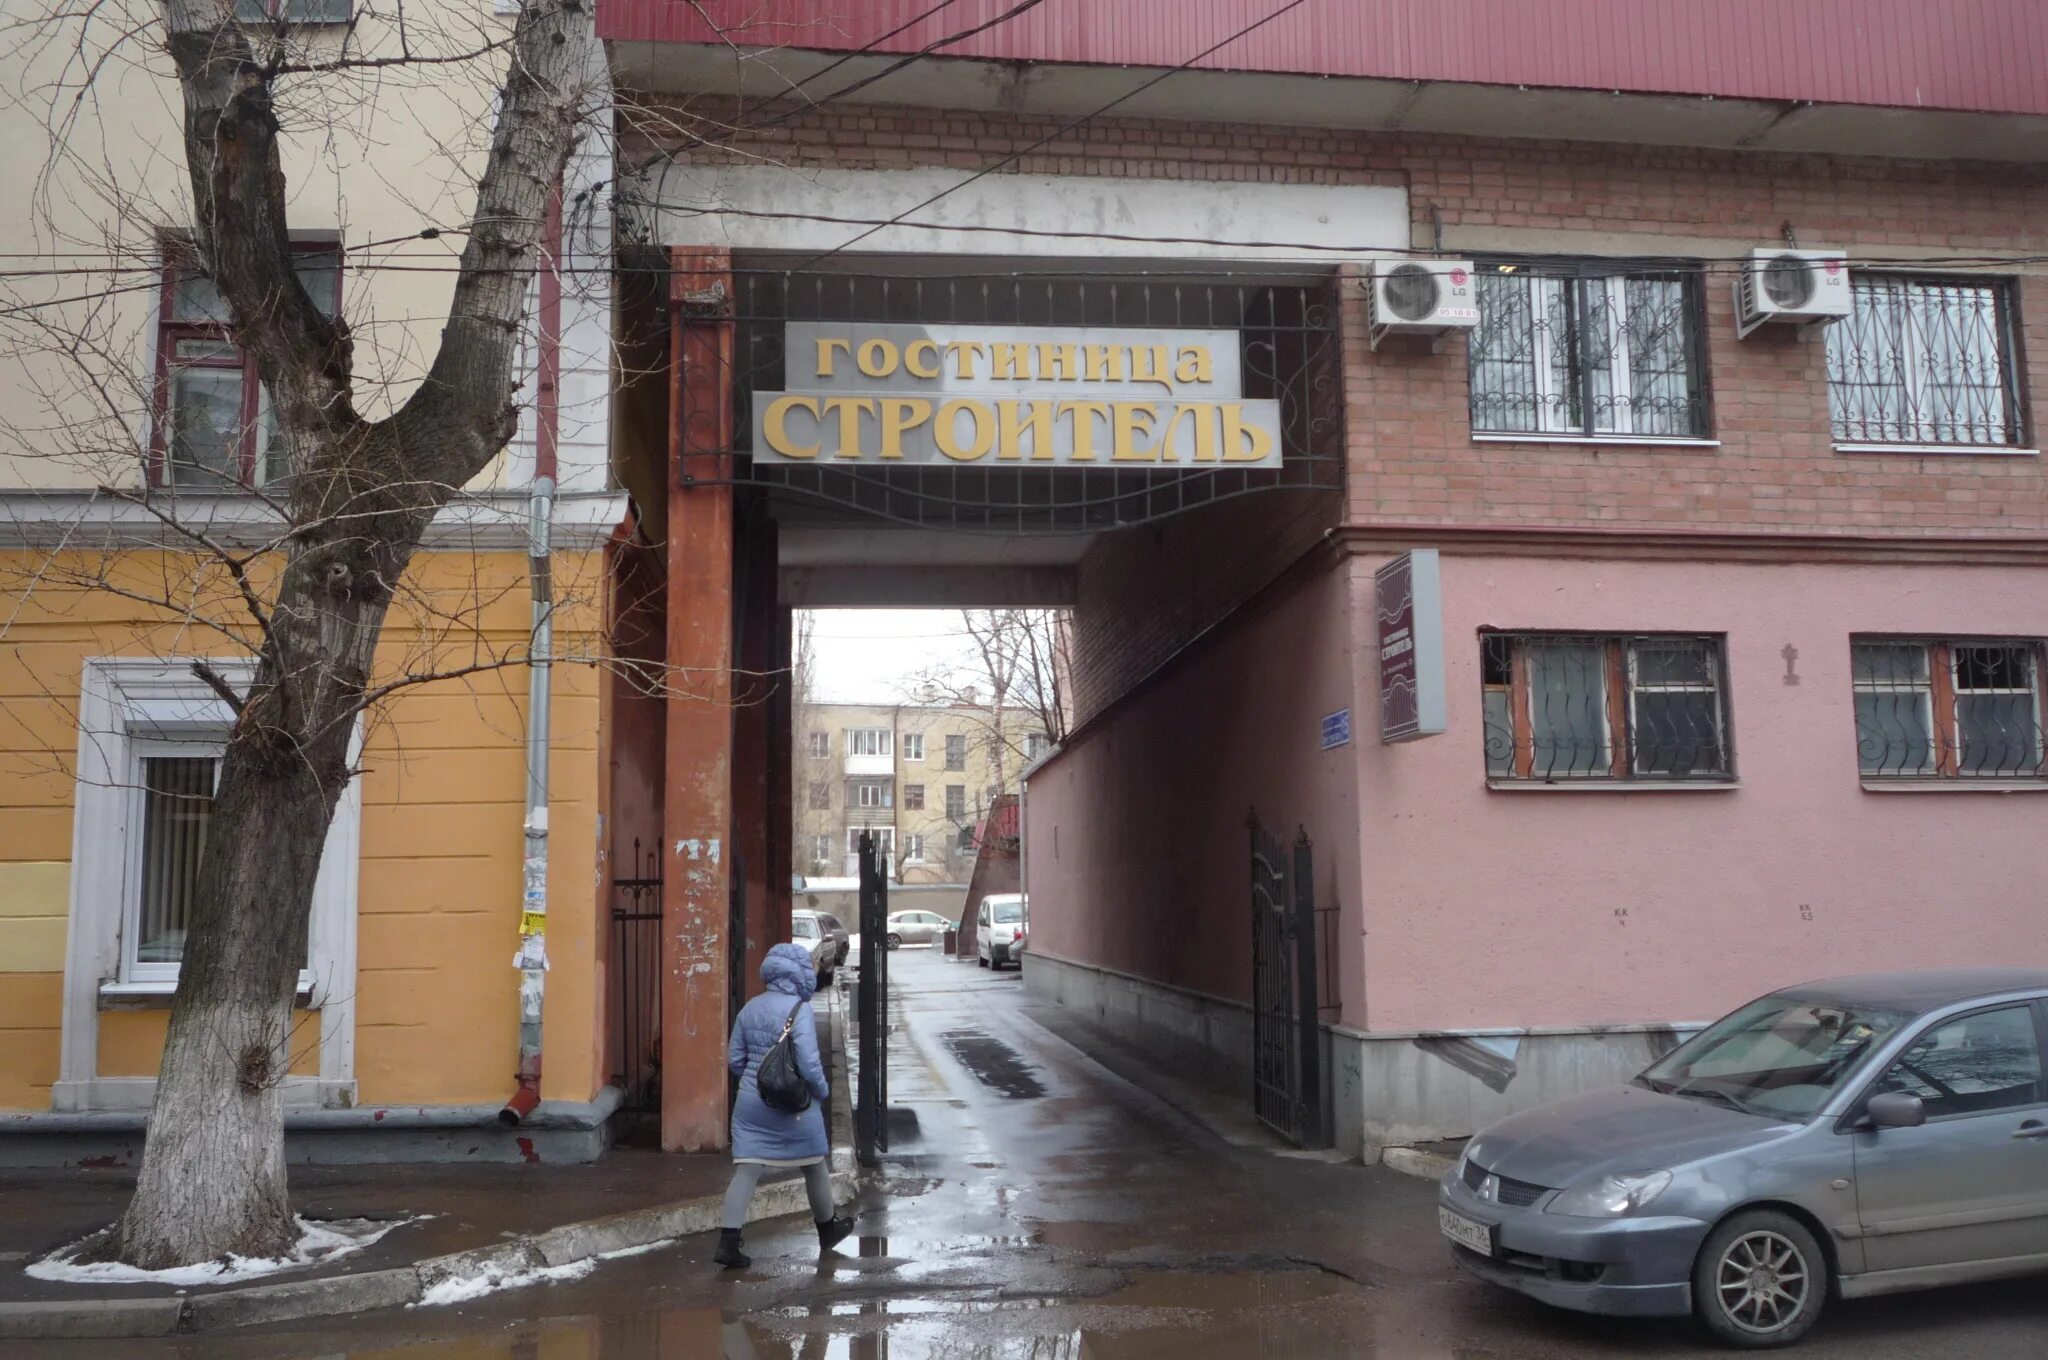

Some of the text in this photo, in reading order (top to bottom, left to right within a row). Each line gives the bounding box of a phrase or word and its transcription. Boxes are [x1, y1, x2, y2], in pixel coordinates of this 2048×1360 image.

[1452, 287, 1467, 296] LG
[1827, 277, 1840, 286] LG
[814, 338, 1213, 395] гостиница
[763, 396, 1273, 463] СТРОИТЕЛЬ
